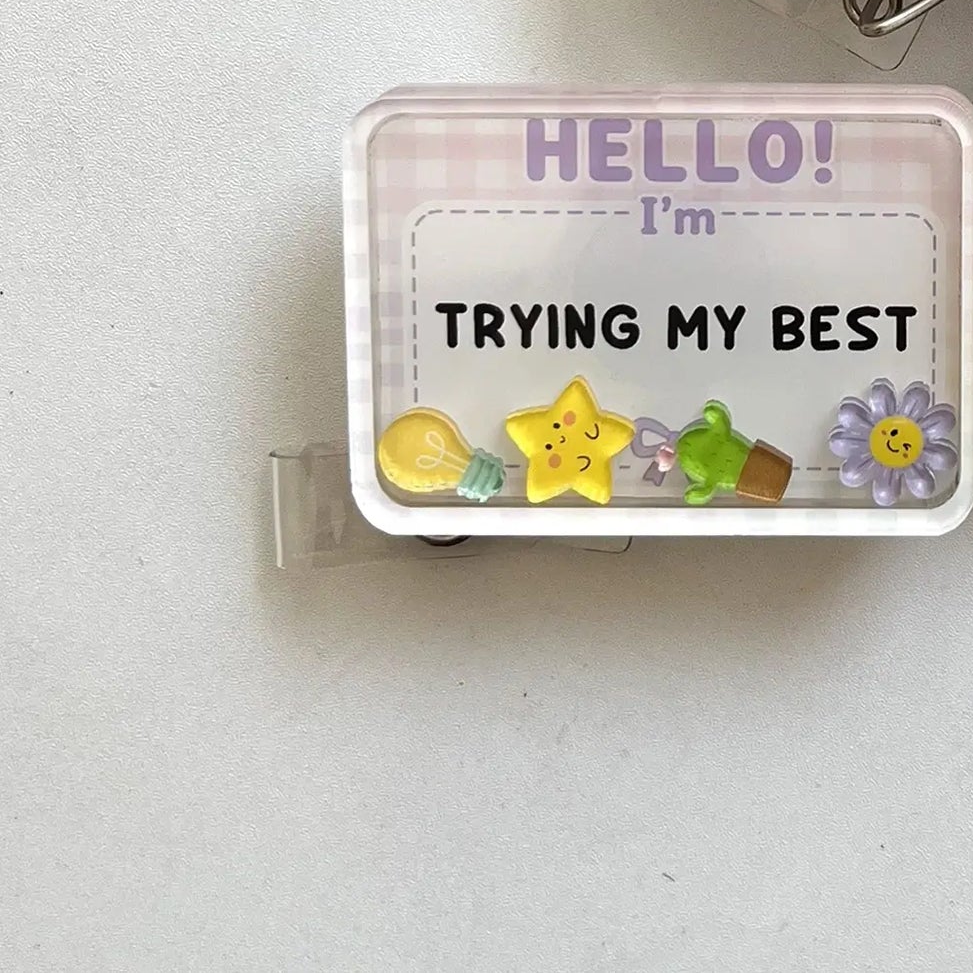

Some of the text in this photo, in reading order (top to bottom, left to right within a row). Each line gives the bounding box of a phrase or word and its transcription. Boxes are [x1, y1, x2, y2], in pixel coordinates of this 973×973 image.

[525, 118, 836, 184] HELLO!
[640, 196, 715, 235] I'm
[436, 303, 917, 352] TRYING MY BEST
